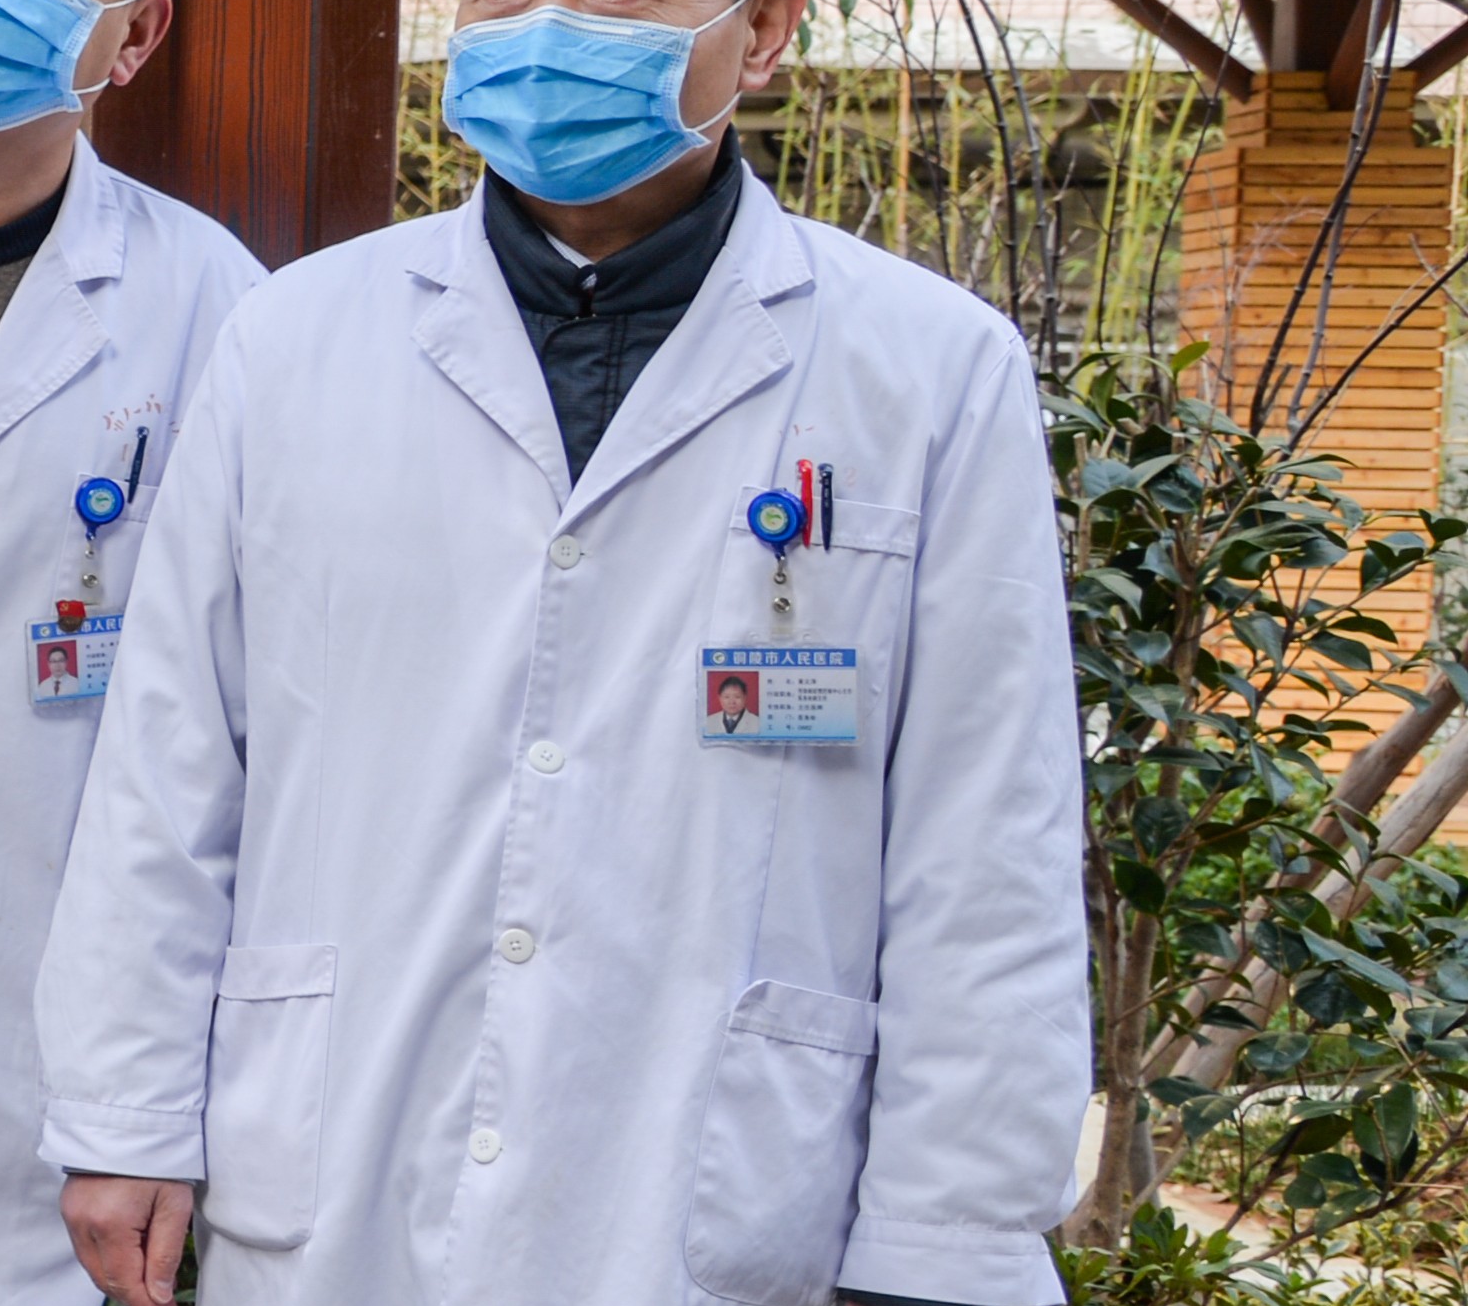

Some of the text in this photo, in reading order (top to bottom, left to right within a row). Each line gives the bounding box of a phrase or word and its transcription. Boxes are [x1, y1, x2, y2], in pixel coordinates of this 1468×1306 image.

[732, 651, 845, 666] 铜陵市人民医院
